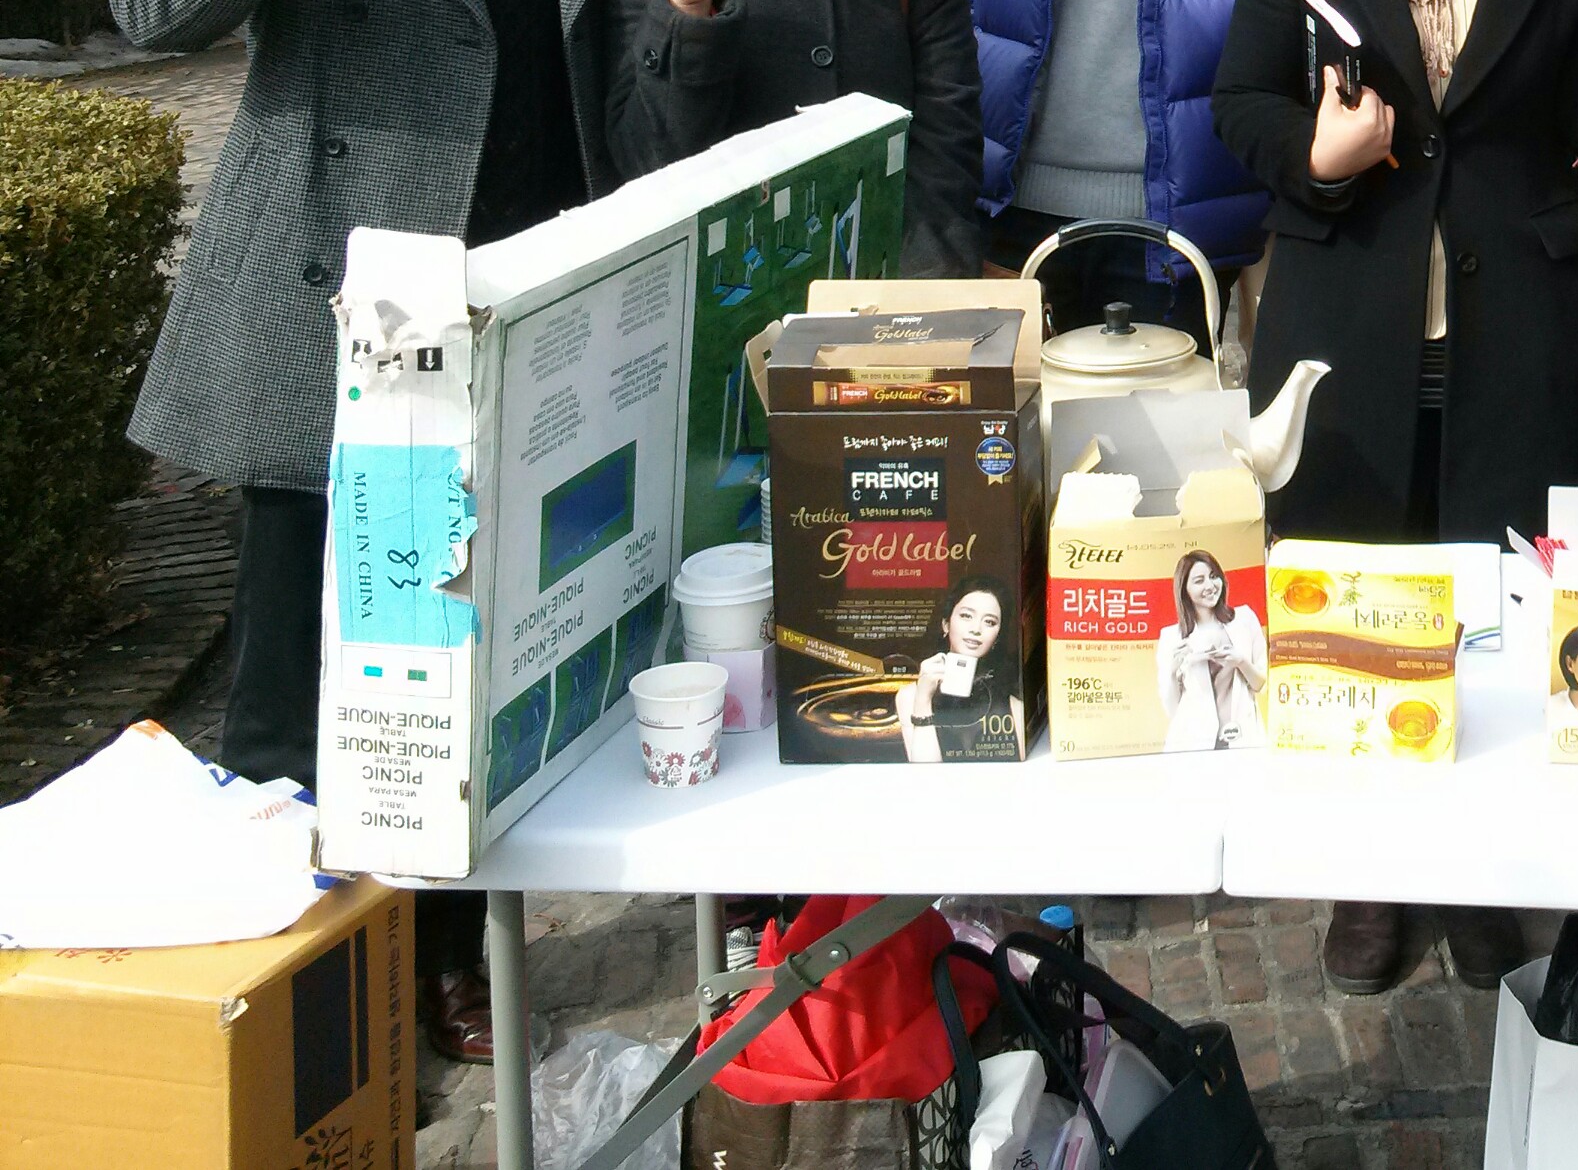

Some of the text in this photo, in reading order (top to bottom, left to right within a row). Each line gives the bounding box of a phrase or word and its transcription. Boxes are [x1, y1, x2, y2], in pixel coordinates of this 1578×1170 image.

[891, 315, 923, 326] FRENCH
[851, 471, 939, 490] FRENCH
[852, 489, 939, 502] CAFE
[790, 506, 855, 529] Arabica
[353, 471, 374, 620] MADE IN CHINA
[624, 525, 658, 560] PICNIC
[386, 548, 422, 590] 83
[622, 568, 655, 604] PICNIC
[512, 577, 585, 643] PIQUE-NIQUE
[1063, 587, 1150, 619] 리치골드
[1063, 621, 1148, 634] RICH GOLD
[511, 609, 584, 677] PIQUE-NIQUE
[336, 706, 452, 730] PIQUE-NIQUE
[980, 714, 1015, 736] 100
[336, 734, 452, 761] PIQUE-NIQUE
[1059, 740, 1076, 754] 50
[373, 756, 411, 767] MESA DE
[361, 764, 424, 785] PICNIC
[368, 785, 417, 798] MESA PARA
[378, 800, 406, 810] TABLE
[360, 810, 424, 831] PICNIC
